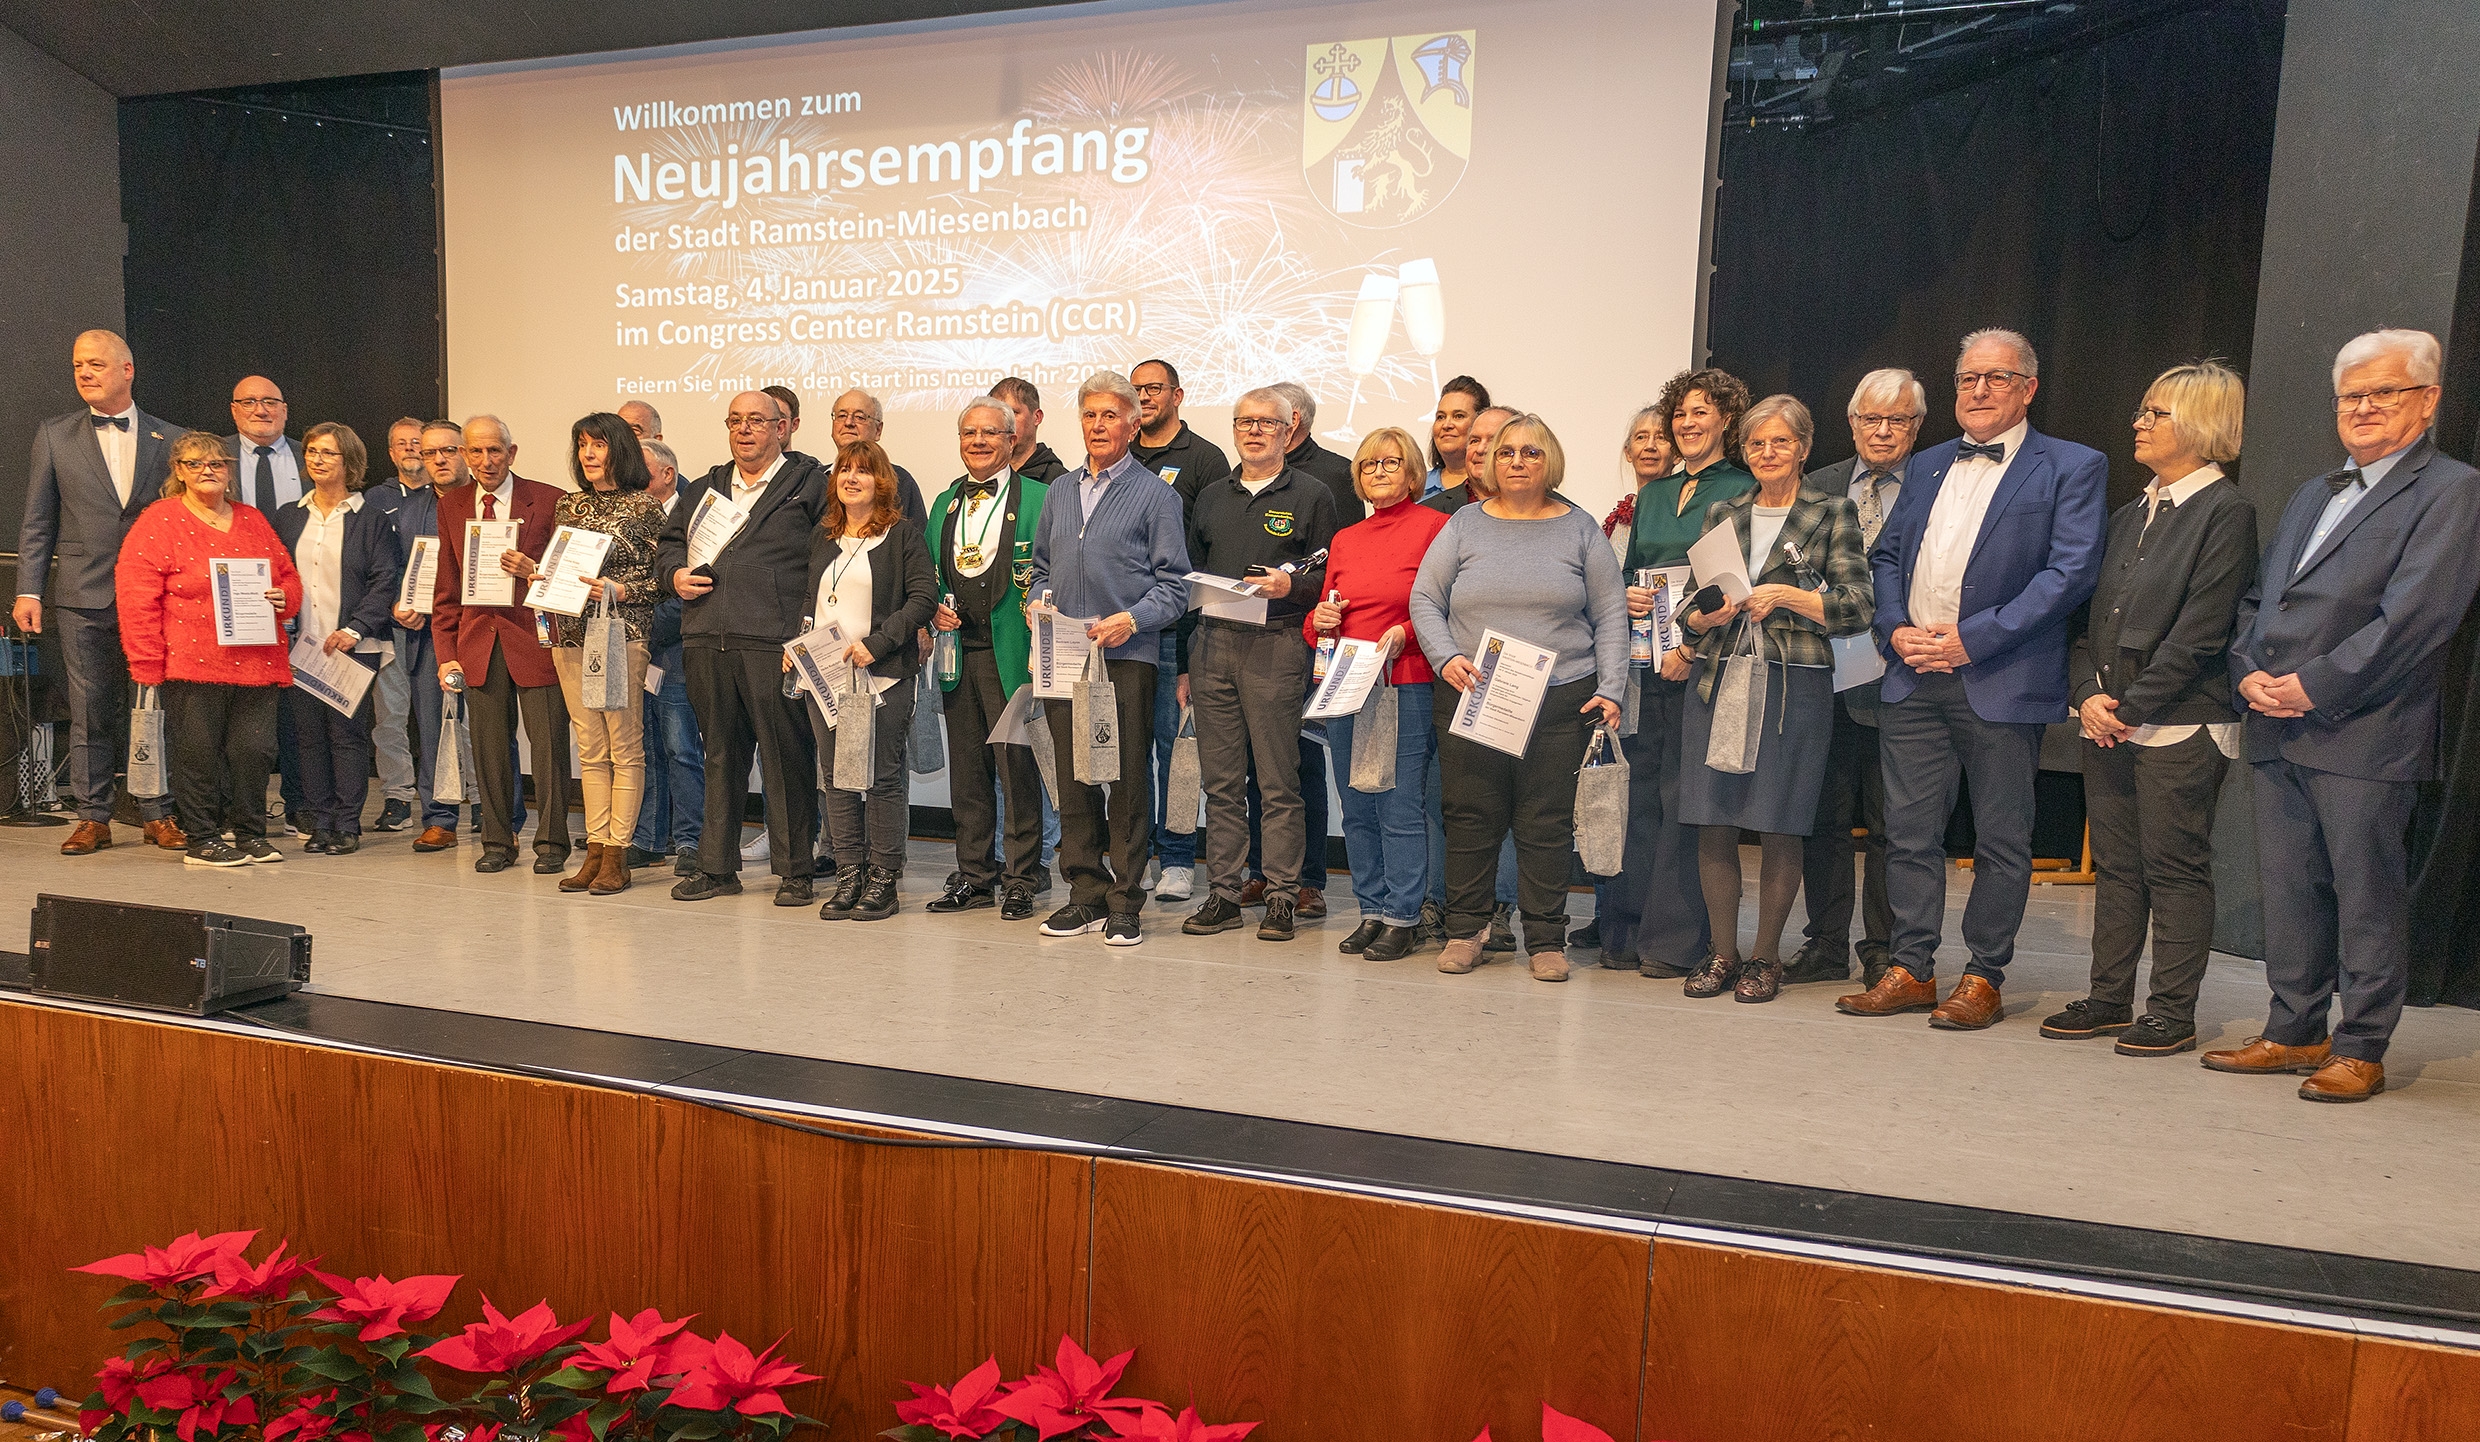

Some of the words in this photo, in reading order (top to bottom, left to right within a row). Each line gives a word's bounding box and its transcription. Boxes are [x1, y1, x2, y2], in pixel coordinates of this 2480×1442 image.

[614, 98, 791, 132] Willkommen
[801, 90, 862, 117] zum
[615, 119, 1150, 209] Neujahrsempfang
[615, 224, 660, 252] der
[668, 220, 740, 250] Stadt
[750, 199, 1088, 246] Ramstein-Miesenbach
[616, 279, 738, 310] Samstag,
[747, 276, 773, 304] 4.
[781, 273, 878, 302] Januar
[887, 268, 960, 297] 2025
[616, 321, 648, 347] im
[657, 313, 781, 350] Congress
[790, 310, 887, 343] Center
[899, 303, 1039, 338] Ramstein
[1050, 301, 1138, 338] (CCR)
[616, 376, 677, 394] Feiern
[683, 375, 712, 392] Sie
[719, 374, 753, 392] mit
[760, 376, 796, 390] uns
[802, 372, 842, 390] den
[850, 370, 901, 389] Start
[909, 368, 940, 387] ins
[947, 369, 1003, 387] neue
[1041, 631, 1052, 688] URKUNDE
[805, 664, 838, 717] URKUNDE
[1317, 664, 1348, 710] URKUNDE
[1462, 663, 1493, 727] URKUNDE
